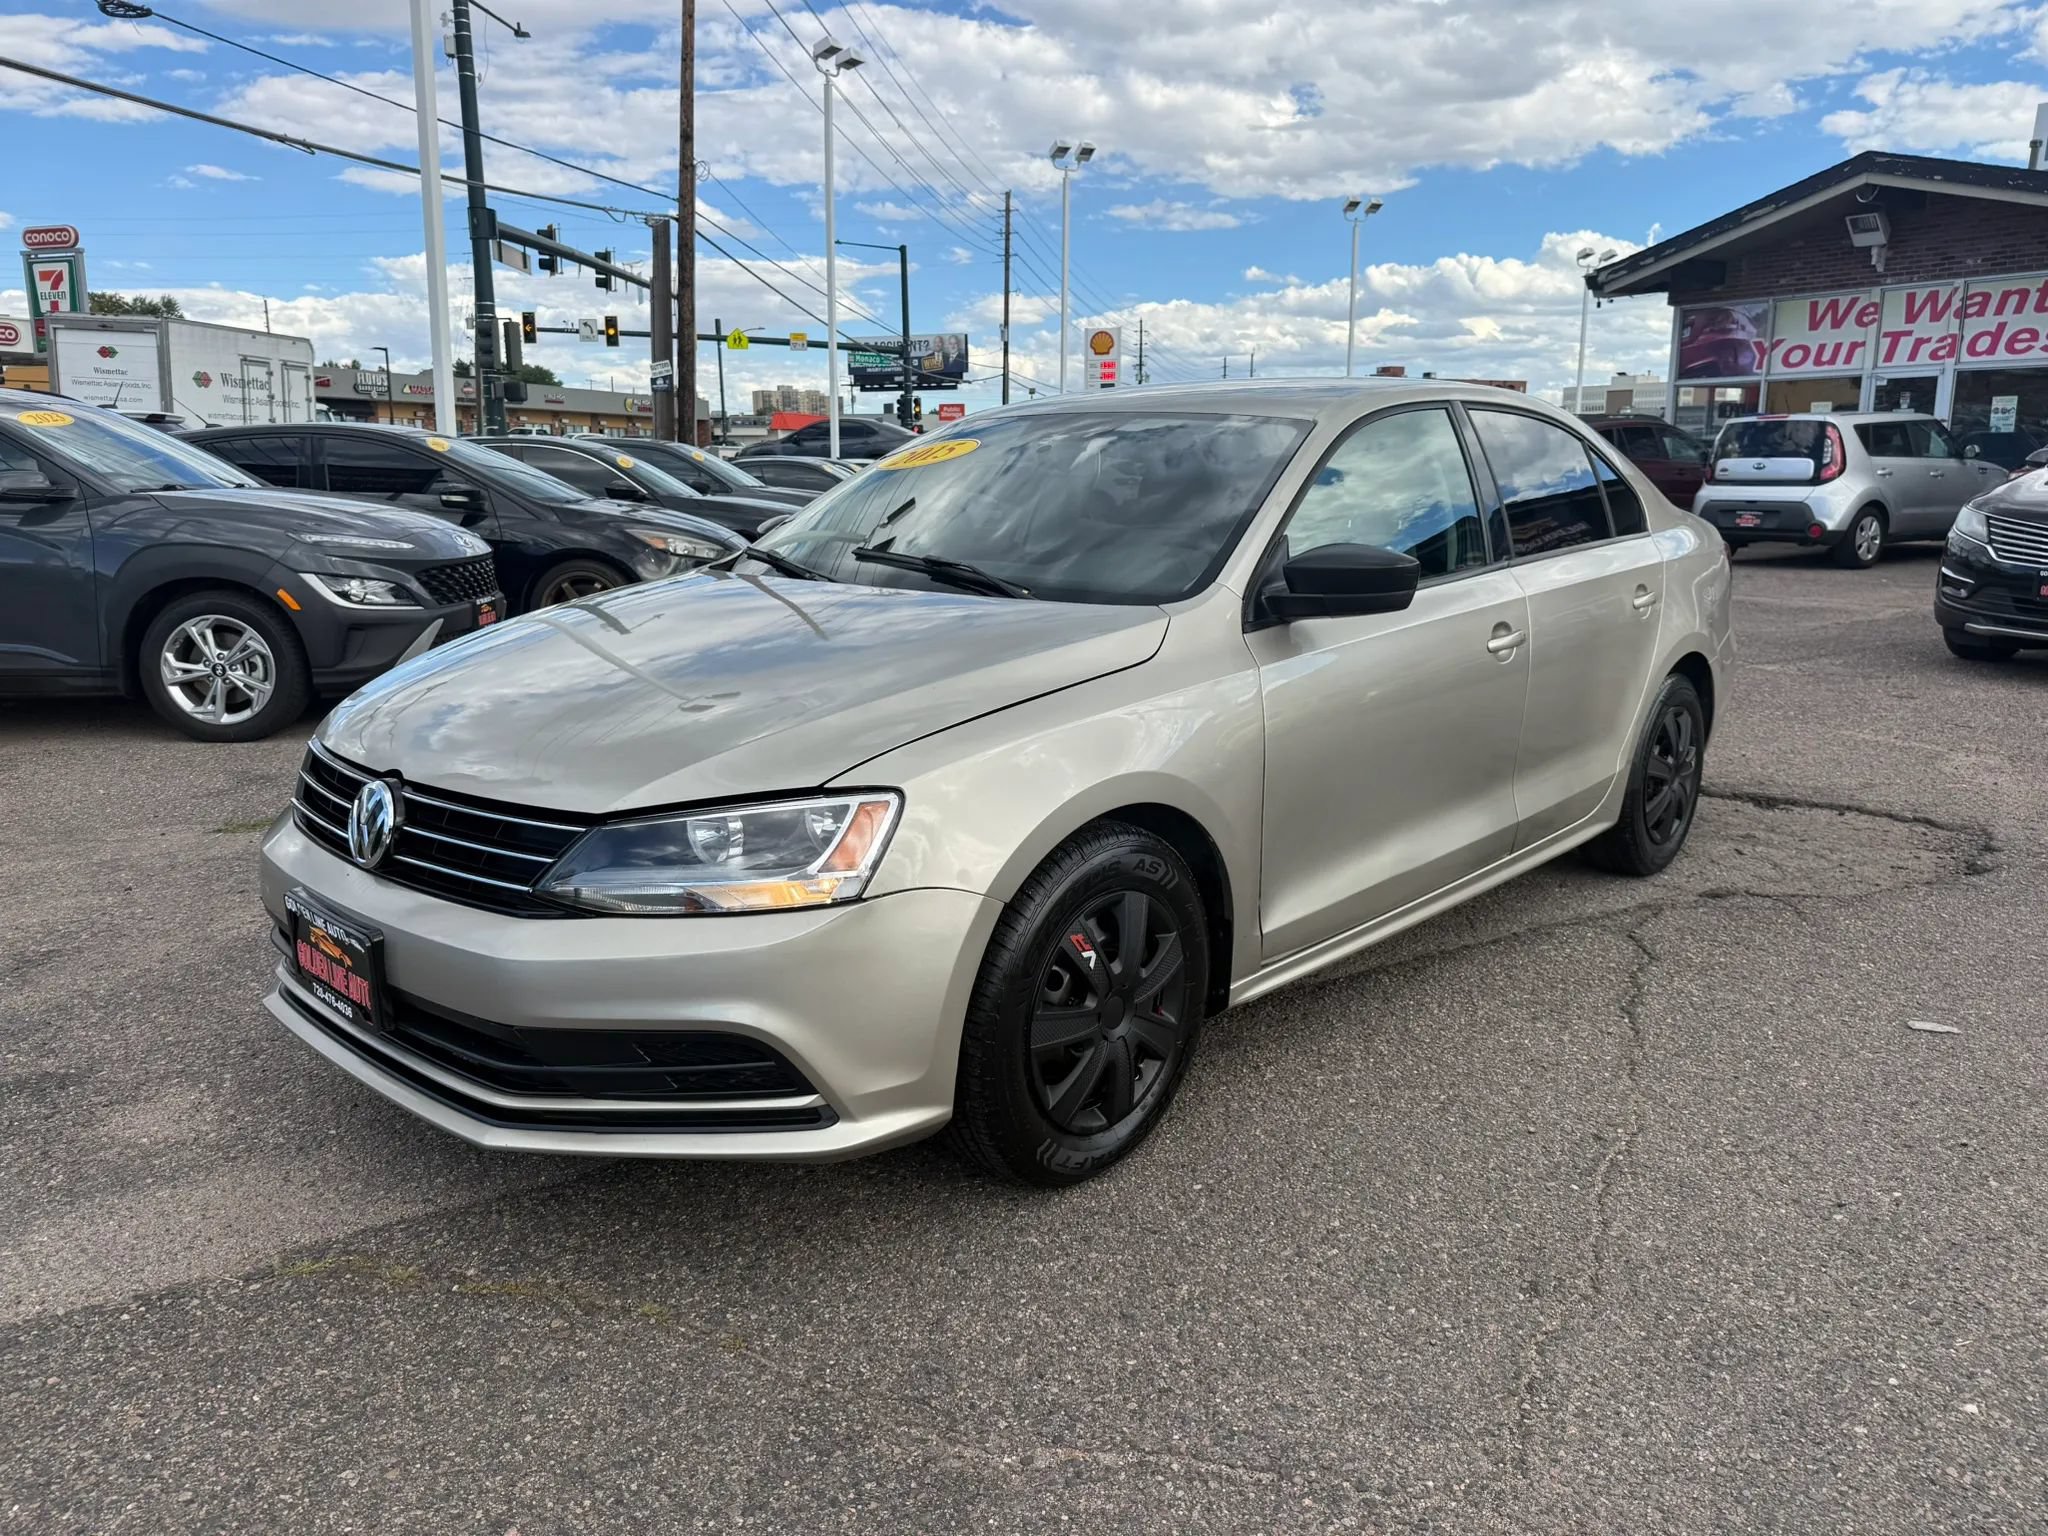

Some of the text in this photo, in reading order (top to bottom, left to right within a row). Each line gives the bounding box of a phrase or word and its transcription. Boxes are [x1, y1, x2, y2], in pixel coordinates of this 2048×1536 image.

[1808, 279, 2048, 331] We Want
[855, 355, 880, 363] Monaco
[1752, 338, 1867, 371] Your
[93, 367, 128, 375] Wismettac
[220, 372, 270, 391] Wismettac
